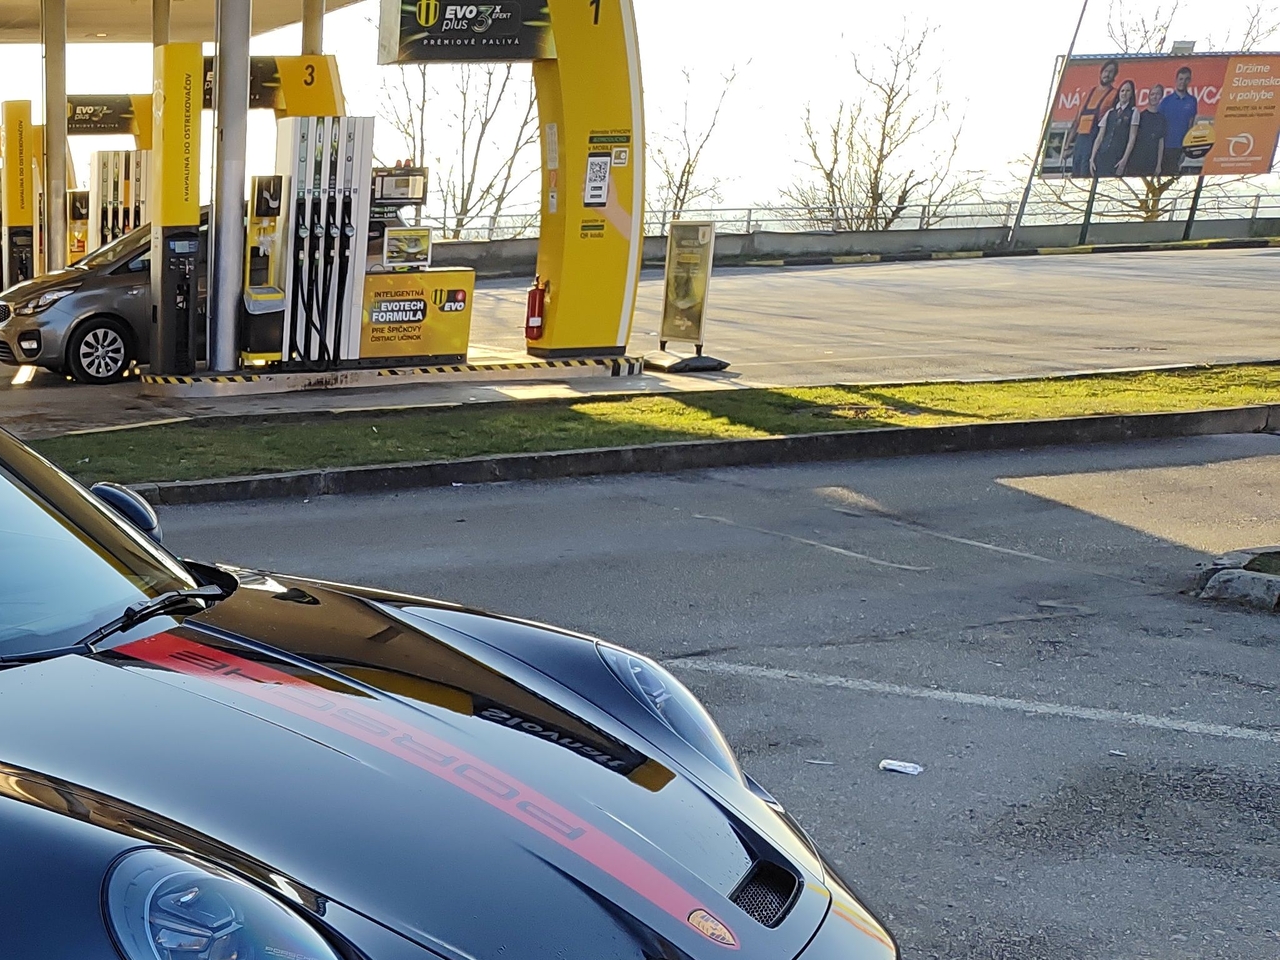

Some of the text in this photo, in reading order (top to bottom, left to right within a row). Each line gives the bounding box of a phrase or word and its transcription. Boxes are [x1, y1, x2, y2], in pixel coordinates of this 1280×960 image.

[444, 5, 478, 19] EVO
[471, 5, 495, 33] 3
[589, 0, 600, 25] 1
[441, 17, 469, 32] plus
[303, 64, 316, 87] 3
[1229, 90, 1274, 102] v pohybe
[76, 105, 94, 114] EVO
[183, 141, 191, 155] DO
[374, 289, 425, 298] INTELIGENTNÁ
[381, 301, 424, 311] EVOTECH
[443, 302, 465, 311] EVO
[372, 311, 424, 323] FORMULA
[167, 650, 587, 841] PORSCHE
